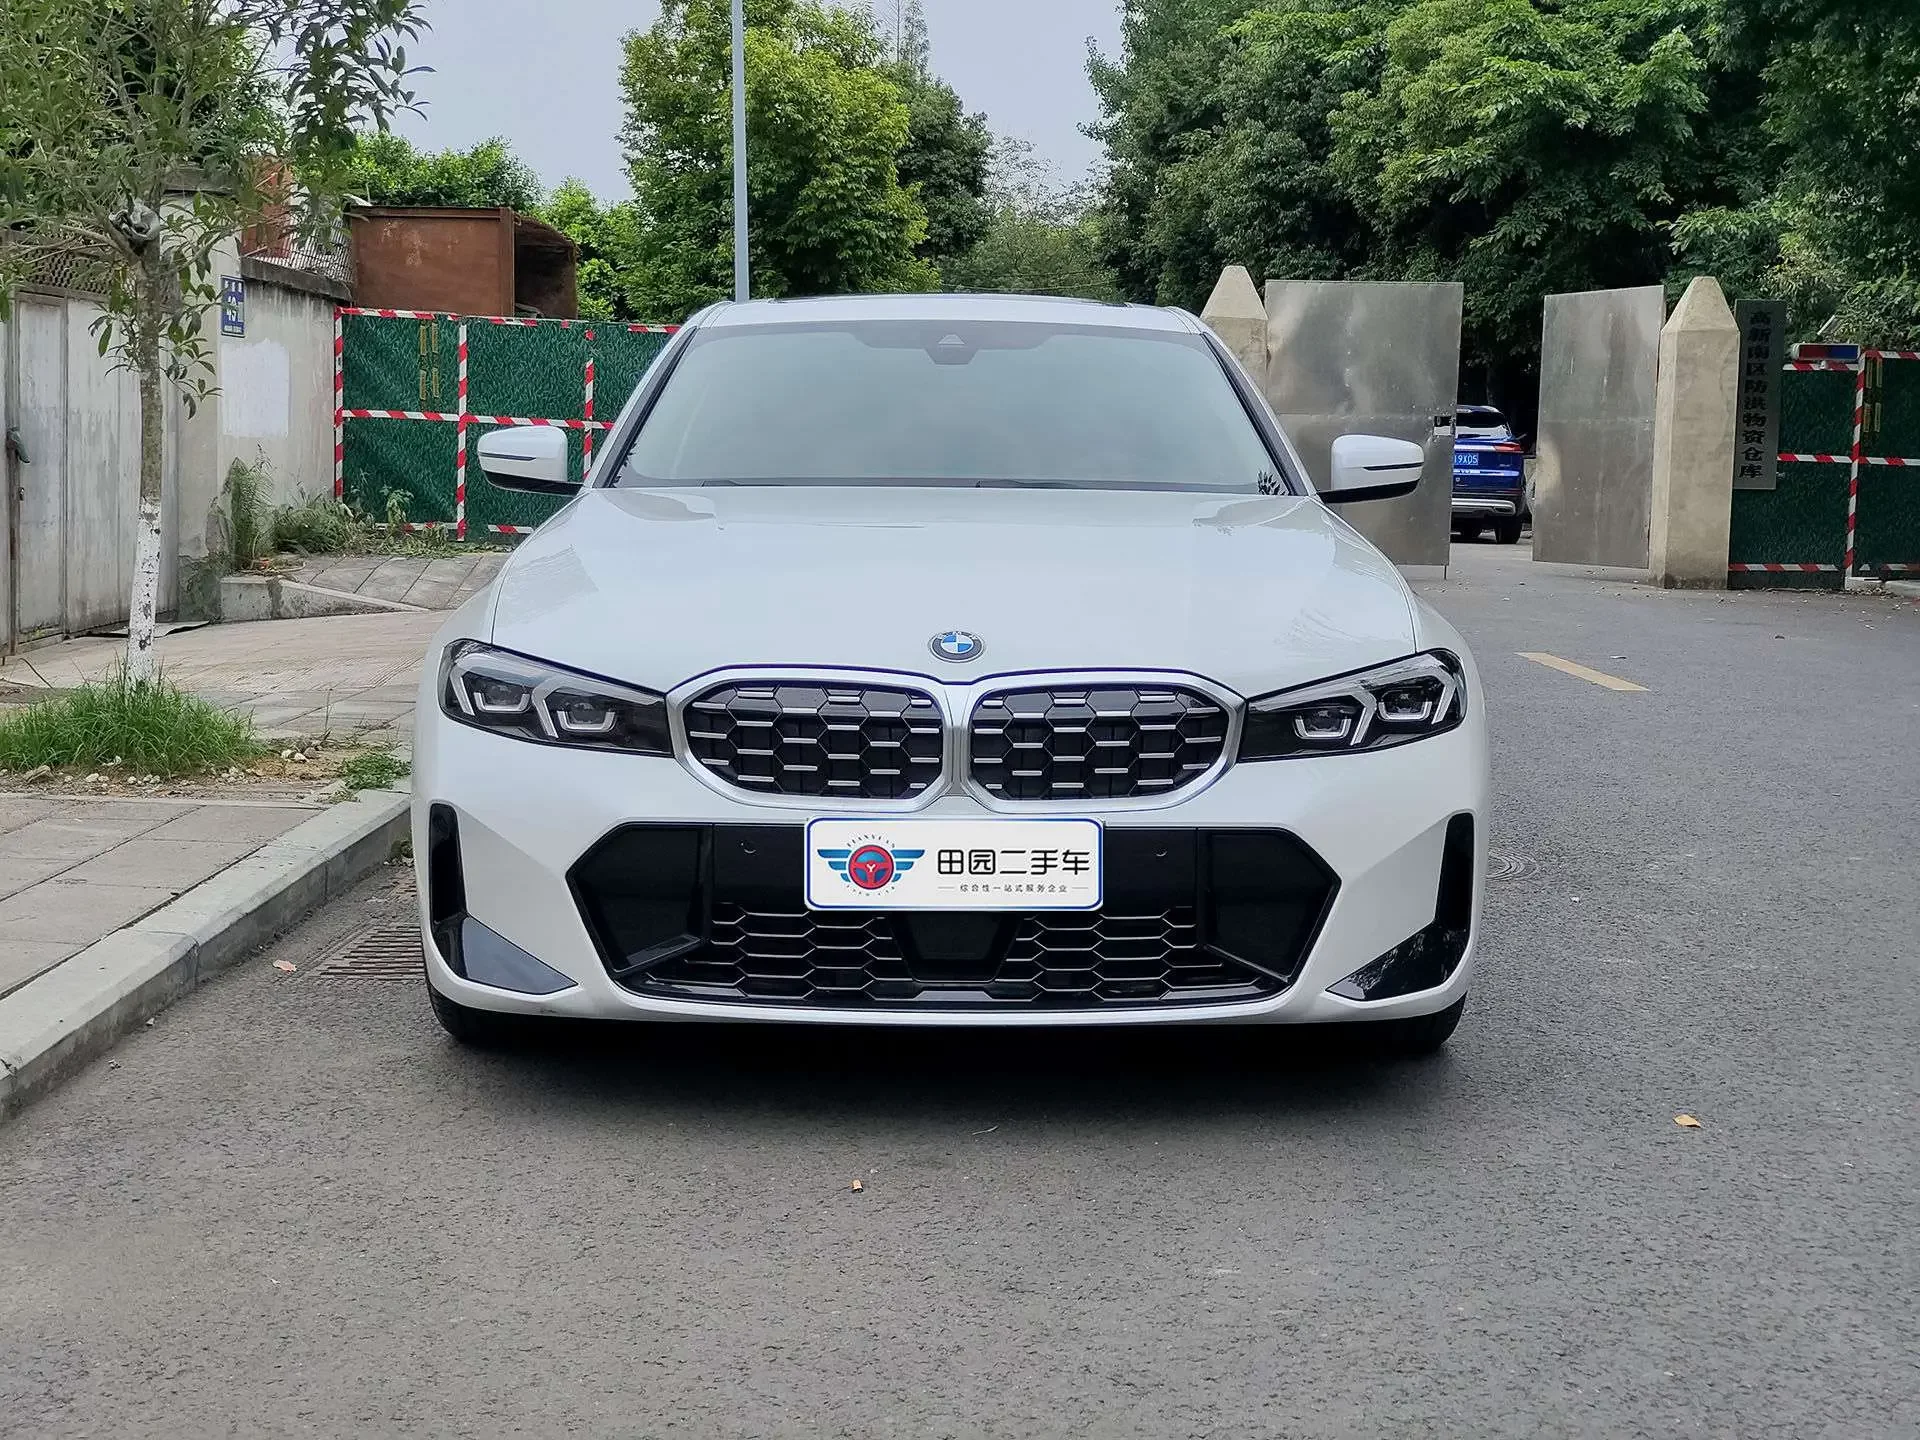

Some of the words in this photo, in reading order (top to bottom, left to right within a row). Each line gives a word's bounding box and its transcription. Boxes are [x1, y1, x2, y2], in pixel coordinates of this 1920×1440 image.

[937, 849, 1091, 876] 田园二手车
[959, 883, 1068, 893] 综合性一站式服务企业
